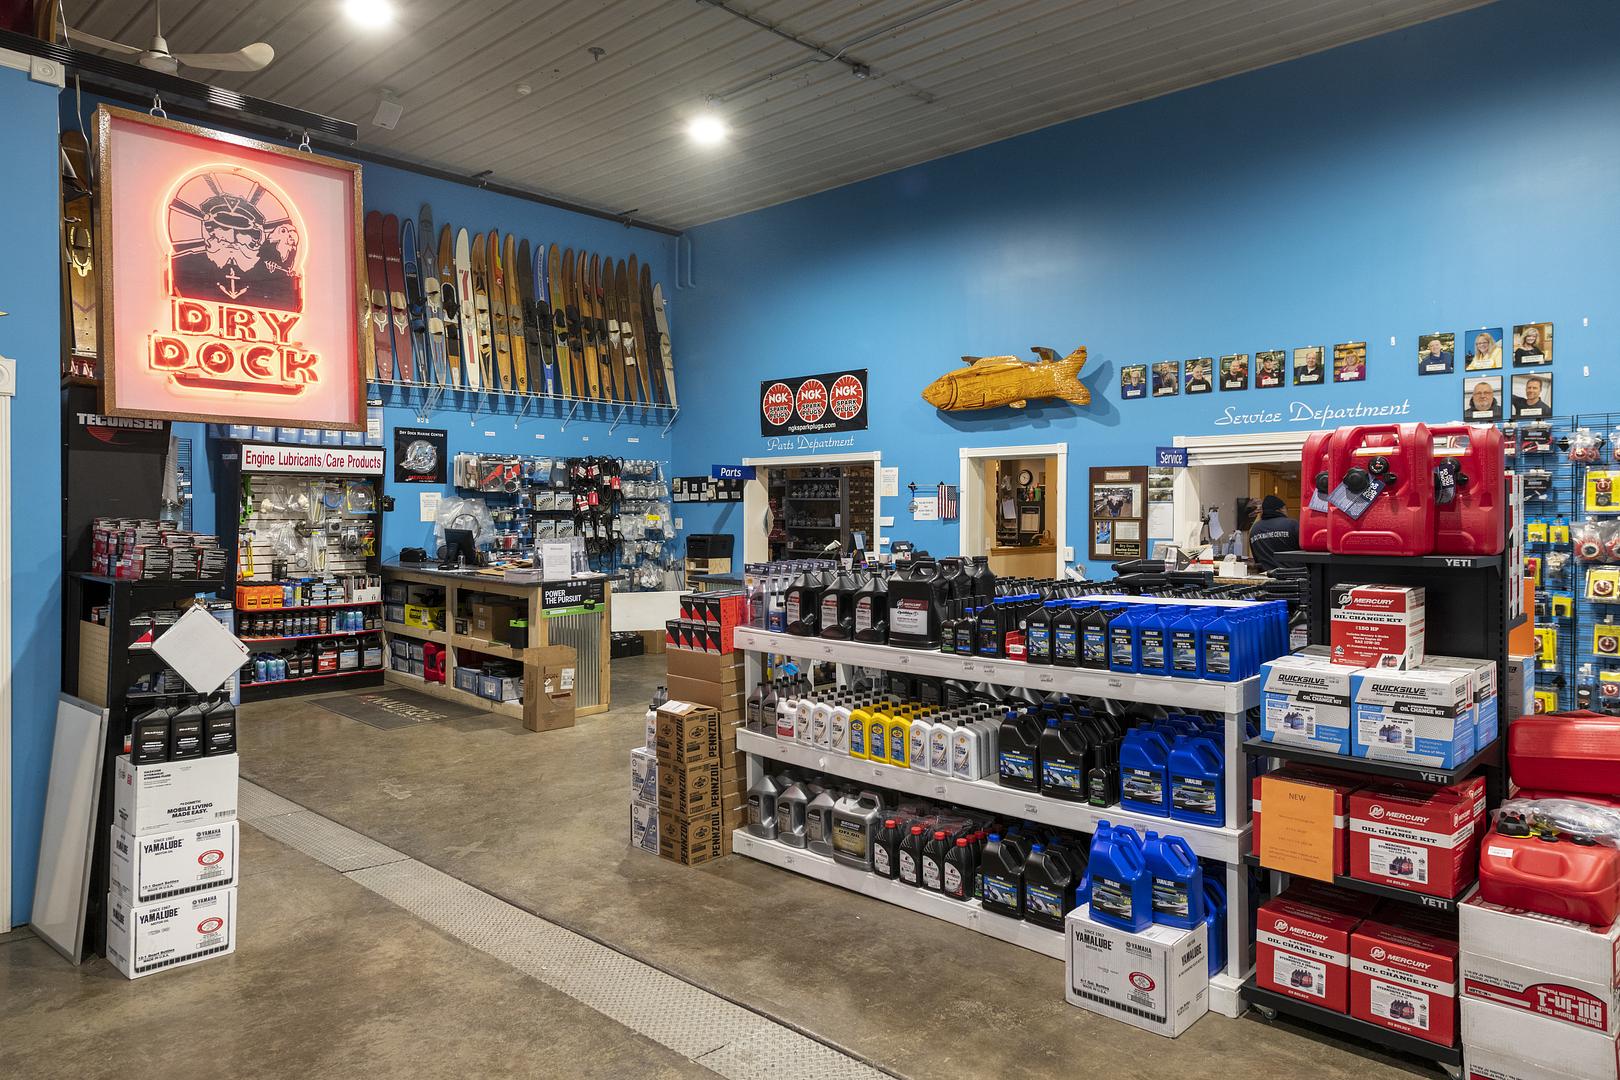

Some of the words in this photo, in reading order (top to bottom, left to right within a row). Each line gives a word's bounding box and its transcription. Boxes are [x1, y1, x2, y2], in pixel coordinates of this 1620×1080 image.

[172, 298, 302, 345] DRY
[148, 334, 320, 384] DOCK
[801, 389, 821, 400] NGK
[835, 385, 857, 397] NGK
[768, 393, 788, 403] NGK
[836, 405, 857, 413] PLUGS
[1214, 406, 1282, 426] Service
[1289, 399, 1411, 428] Department
[77, 413, 163, 429] TECUMSEH
[788, 422, 836, 432] ngksparkplugs.com
[767, 437, 794, 451] Parts
[797, 434, 855, 454] Department
[245, 451, 275, 467] Engine
[278, 452, 344, 468] Lubricants/Care
[348, 454, 381, 469] Products
[1160, 451, 1183, 465] Service
[720, 466, 742, 477] Parts
[1445, 559, 1472, 567] YETI
[545, 589, 565, 598] POWER
[545, 597, 557, 605] THE
[558, 594, 582, 604] PURSUIT
[1278, 674, 1325, 684] QUICKSILVE
[1371, 684, 1426, 695] QUICKSILVE
[1410, 707, 1434, 715] CHANGE
[708, 713, 717, 757] PENNZOIL
[710, 762, 719, 807] PENNZOIL
[1420, 772, 1447, 784] YETI
[1289, 793, 1306, 802] NEW
[166, 806, 191, 814] MOBILE
[192, 802, 213, 811] LIVING
[171, 811, 191, 819] MADE
[191, 808, 208, 816] EASY.
[1385, 811, 1430, 823] MERCURY
[201, 828, 221, 837] YAMAHA
[712, 812, 720, 857] PENNZOIL
[1378, 827, 1418, 840] CHANGE
[1420, 836, 1437, 844] KIT
[144, 839, 182, 854] YAMALUBE
[197, 896, 217, 904] YAMAHA
[1420, 896, 1448, 910] YETI
[139, 908, 178, 924] YAMALUBE
[1289, 926, 1328, 941] MERCURY
[1075, 930, 1112, 951] YAMALUBE
[1131, 943, 1152, 954] YAMAHA
[1267, 937, 1281, 945] OIL
[1282, 940, 1317, 956] CHANGE
[1319, 952, 1334, 960] KIT
[1387, 954, 1431, 970] MERCURY
[1362, 965, 1378, 974] OIL
[1380, 969, 1419, 985] CHANGE
[1421, 981, 1439, 990] KIT
[1537, 991, 1602, 1022] All-in-1
